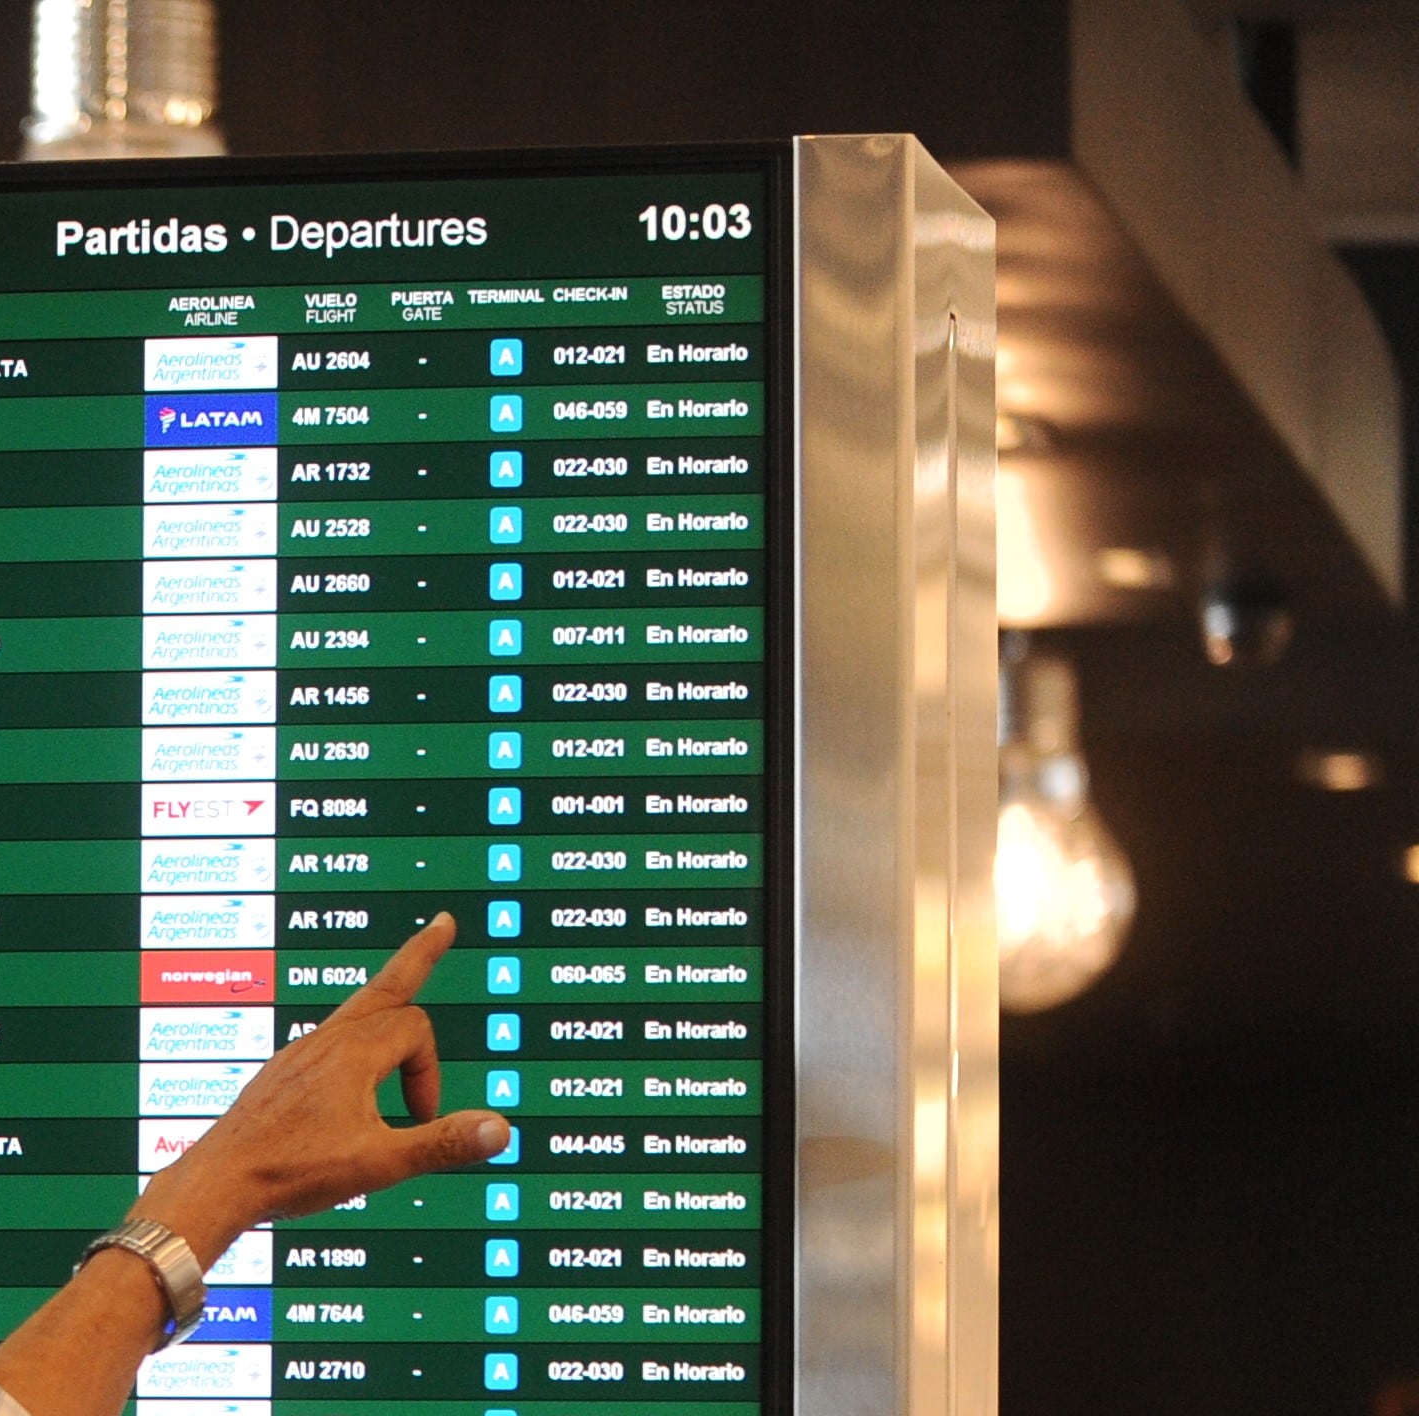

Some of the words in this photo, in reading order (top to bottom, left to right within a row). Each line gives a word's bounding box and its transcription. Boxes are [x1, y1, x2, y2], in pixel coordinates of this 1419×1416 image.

[57, 218, 227, 256] Partidas
[271, 213, 487, 258] Departures
[639, 204, 751, 240] 10:03
[169, 296, 255, 311] AEROLINEA
[305, 293, 357, 307] VUELO
[392, 291, 453, 305] PUERTA
[467, 289, 544, 303] TERMINAL
[553, 287, 627, 301] CHECK-IN
[662, 284, 725, 299] ESTADO
[185, 312, 237, 326] AIRLINE
[306, 309, 356, 323] FLIGHT
[403, 307, 442, 321] GATE
[666, 300, 723, 315] STATUS
[181, 411, 262, 427] LATAM
[293, 407, 320, 425] 4M
[325, 406, 369, 424] 7504
[499, 404, 514, 422] A
[554, 401, 627, 419] 046-059
[647, 400, 673, 418] En
[679, 399, 748, 417] Horario
[151, 801, 234, 819] FLYEST
[291, 799, 319, 817] FQ
[323, 799, 367, 816] 8084
[497, 796, 513, 814] A
[552, 796, 624, 814] 001-001
[646, 795, 673, 813] En
[677, 795, 747, 812] Horario
[286, 1249, 316, 1266] AR
[321, 1249, 366, 1266] 1890
[494, 1248, 510, 1266] A
[549, 1249, 621, 1266] 012-021
[643, 1249, 670, 1266] En
[675, 1249, 745, 1266] Horario
